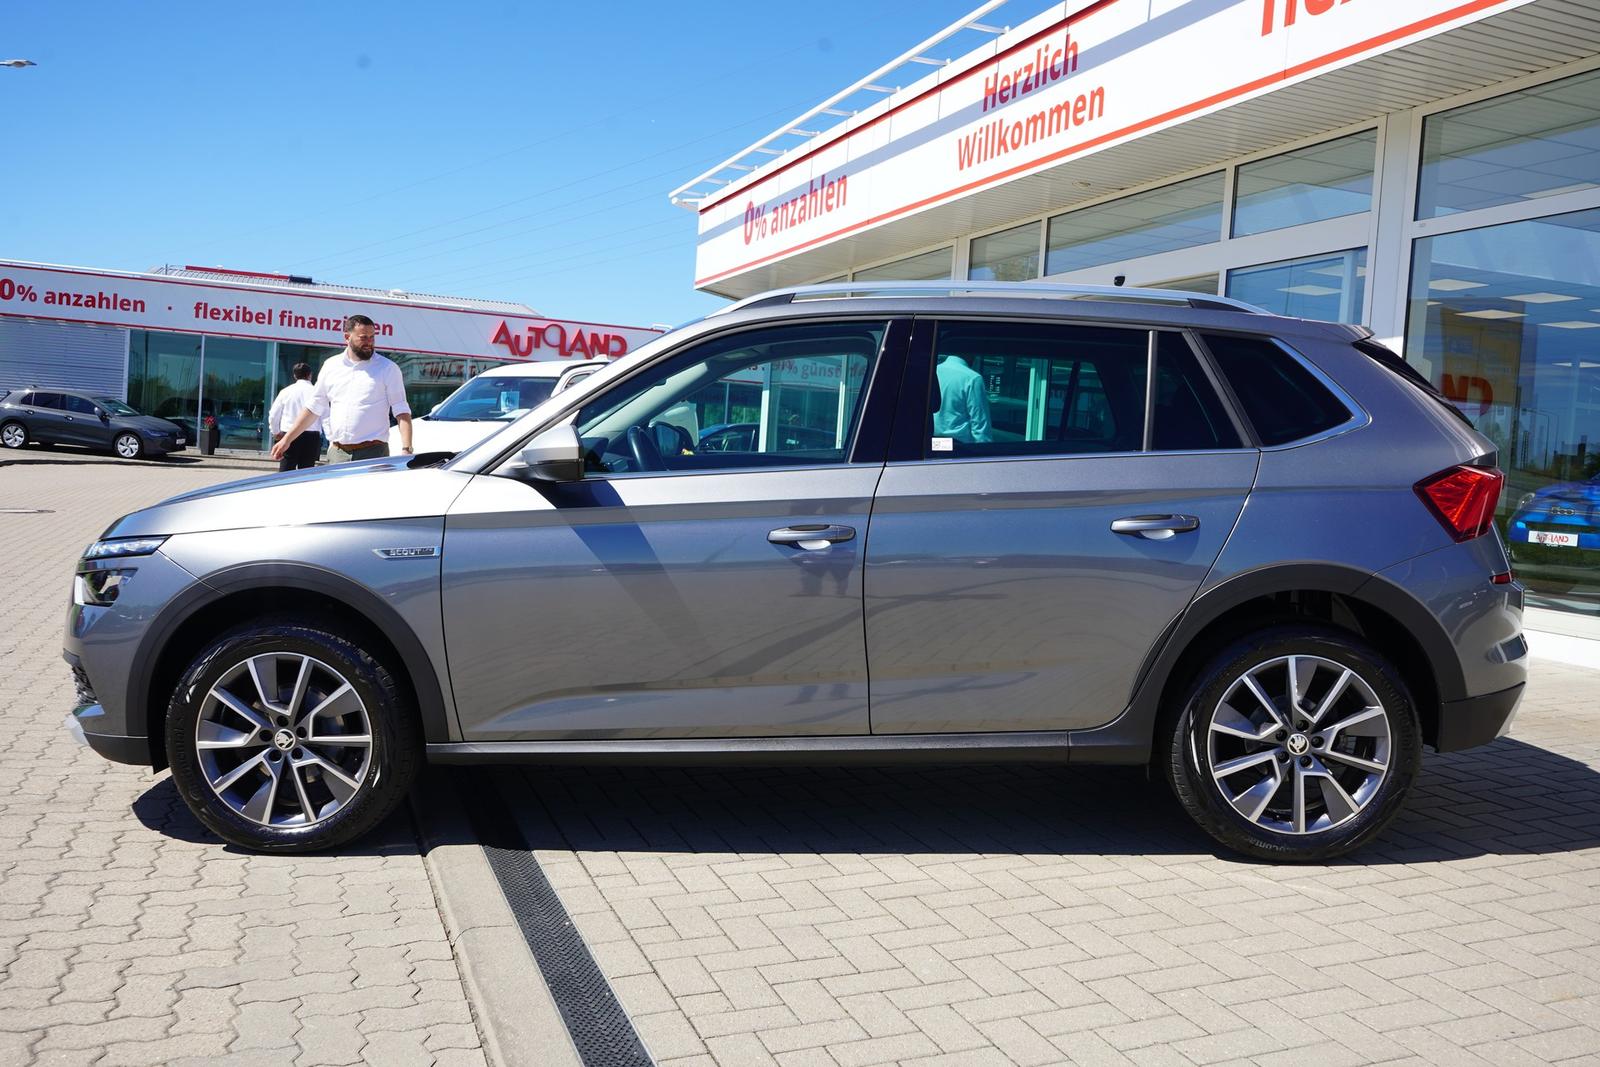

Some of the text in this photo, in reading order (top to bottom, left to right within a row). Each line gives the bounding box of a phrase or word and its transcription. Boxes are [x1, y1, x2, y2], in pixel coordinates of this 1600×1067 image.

[983, 34, 1079, 113] Herzlich
[957, 86, 1105, 171] Willkommen
[743, 172, 847, 246] 0% anzahlen
[0, 278, 393, 336] 0% anzahlen flexibel finanzien
[492, 319, 628, 360] AUTOLAND
[389, 548, 421, 556] SCOUT
